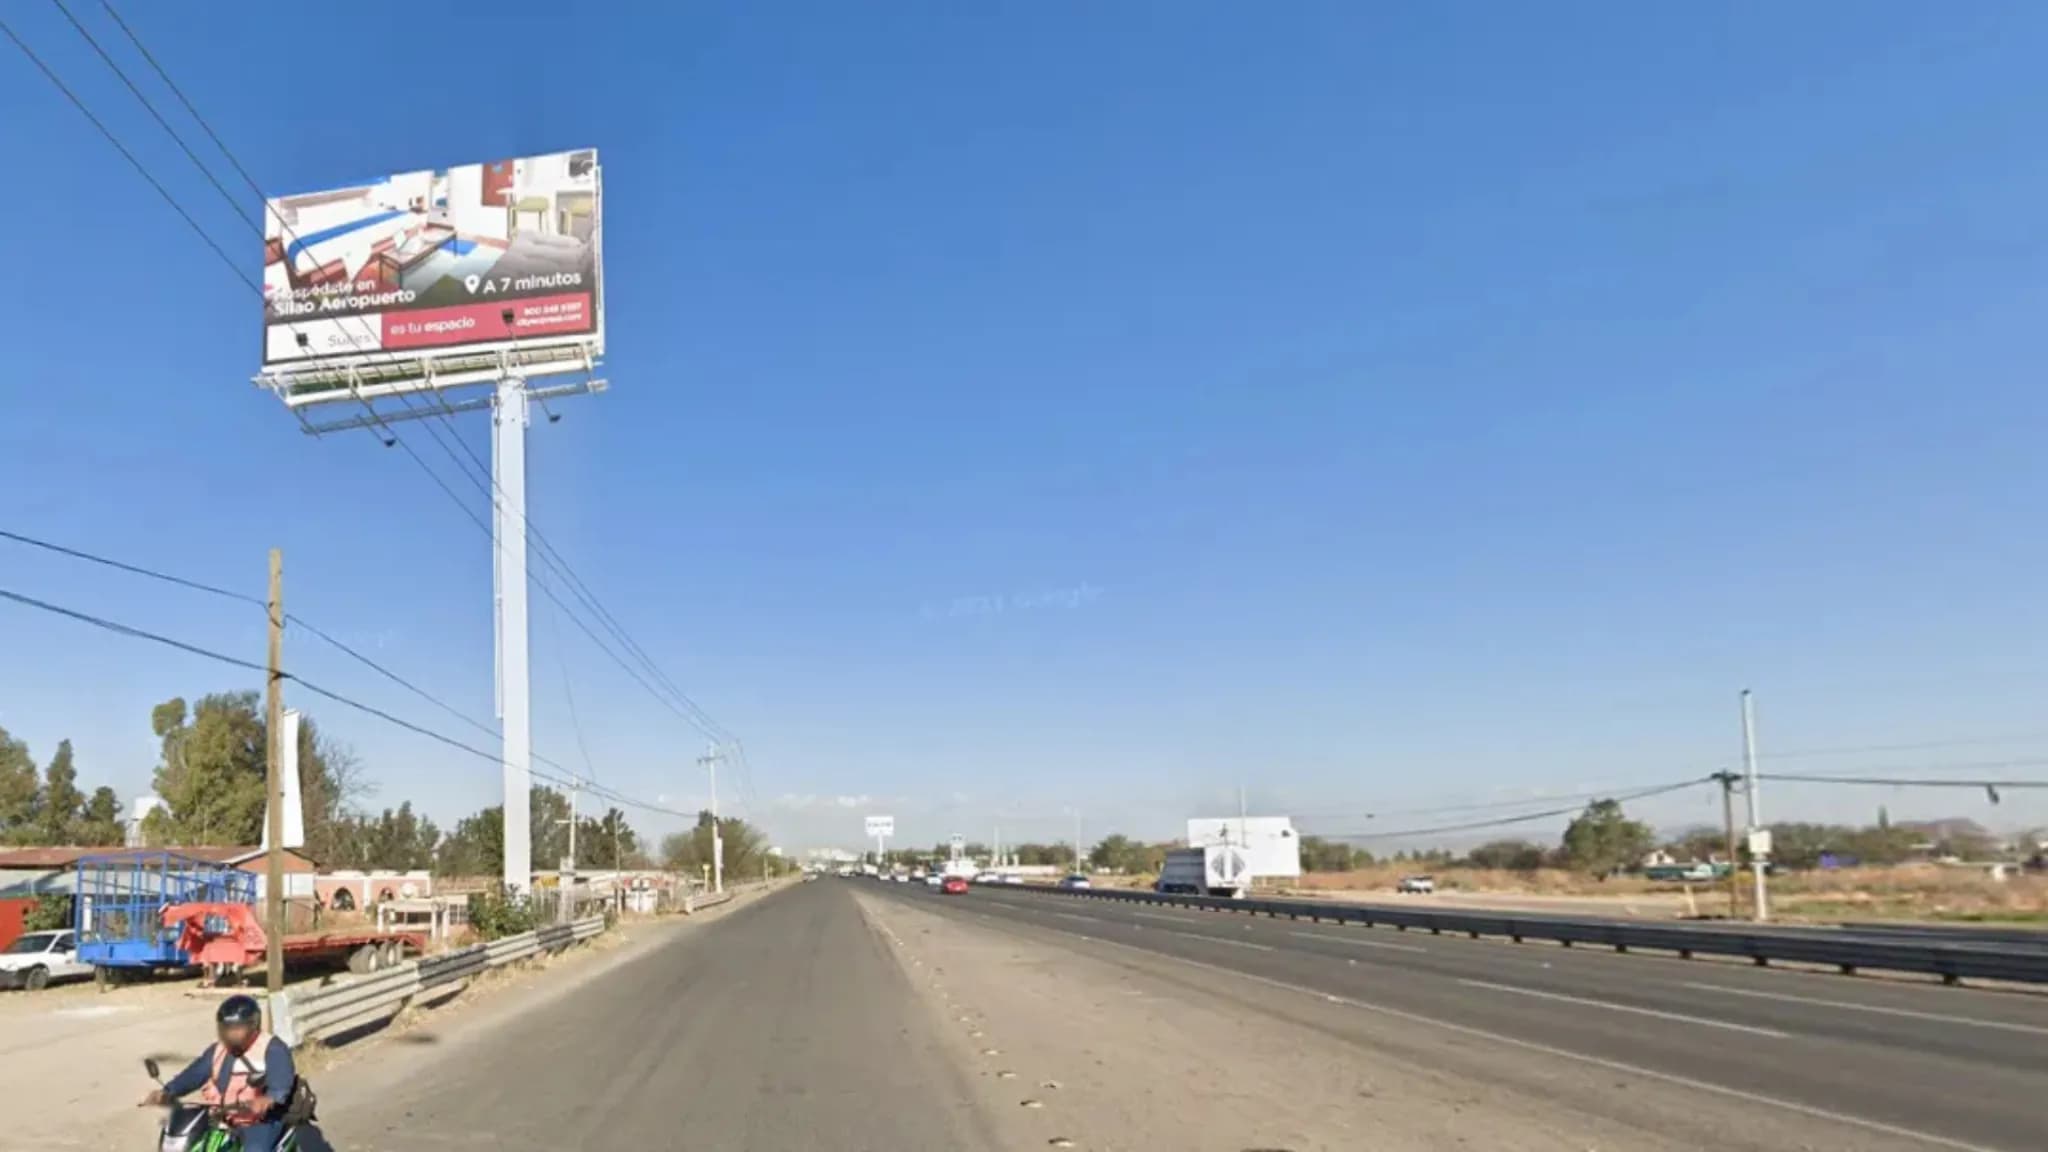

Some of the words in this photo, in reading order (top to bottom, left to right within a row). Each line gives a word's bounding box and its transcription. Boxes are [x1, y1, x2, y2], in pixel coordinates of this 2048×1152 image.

[483, 280, 497, 294] A
[500, 278, 512, 292] 7
[515, 272, 582, 290] minutos
[319, 289, 416, 311] Aeropuerto
[390, 325, 405, 335] es
[408, 322, 421, 333] tu
[424, 316, 476, 333] espacio
[327, 334, 372, 347] Sues
